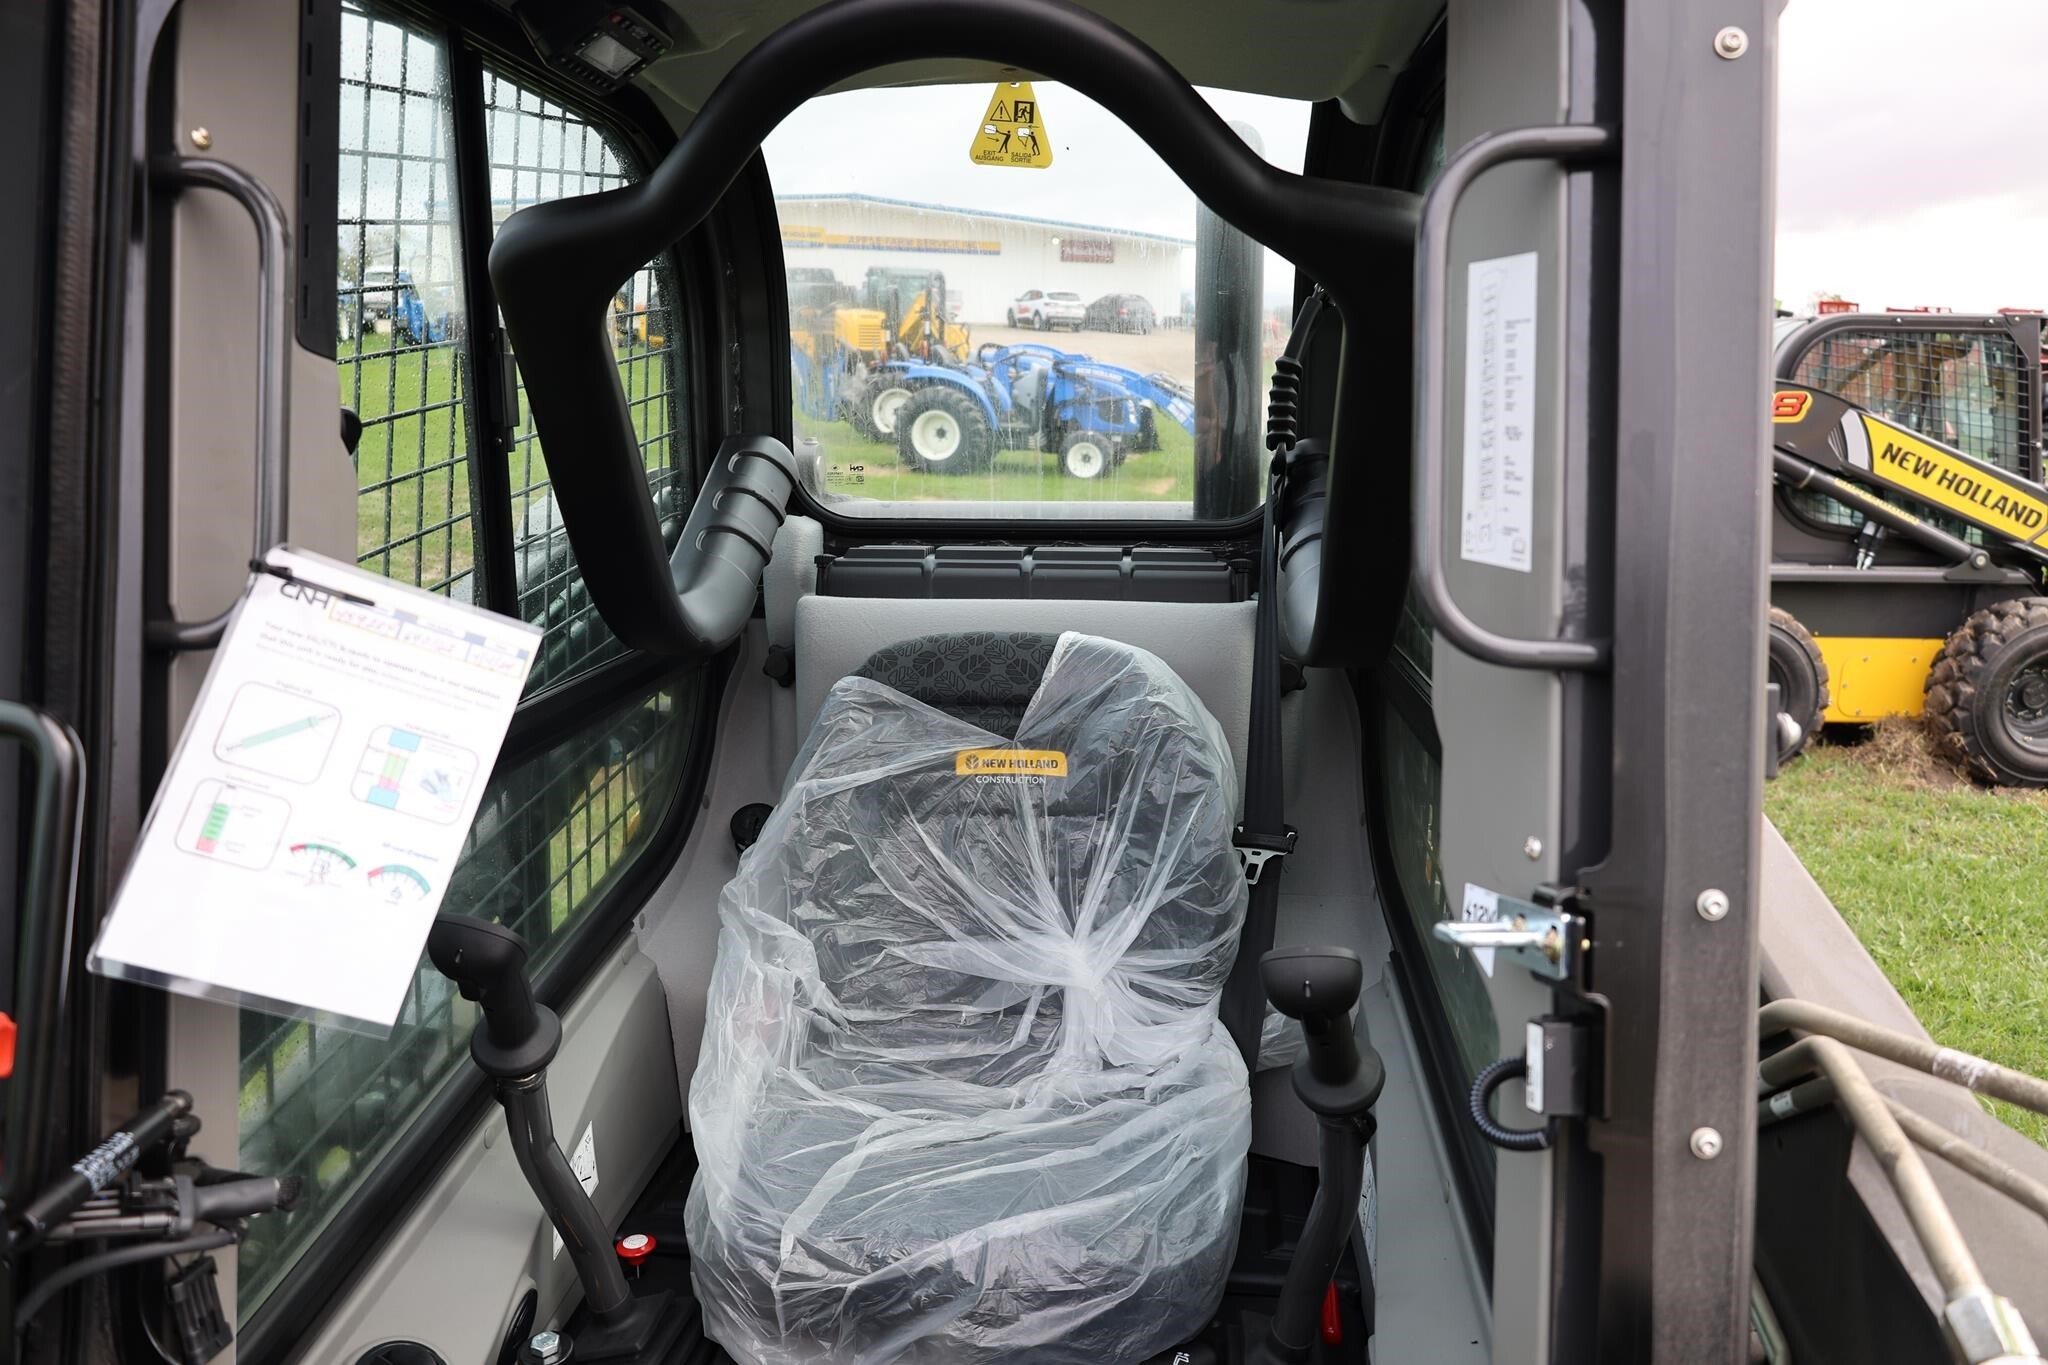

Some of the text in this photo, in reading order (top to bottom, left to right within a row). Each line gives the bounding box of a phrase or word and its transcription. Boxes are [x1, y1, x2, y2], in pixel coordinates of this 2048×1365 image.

[1880, 442, 1938, 479] NEW
[1937, 469, 2043, 529] HOLLAND
[280, 581, 331, 610] CNH
[982, 758, 1059, 769] NEW HOLLAND
[975, 775, 1047, 784] CONSTRUCTION
